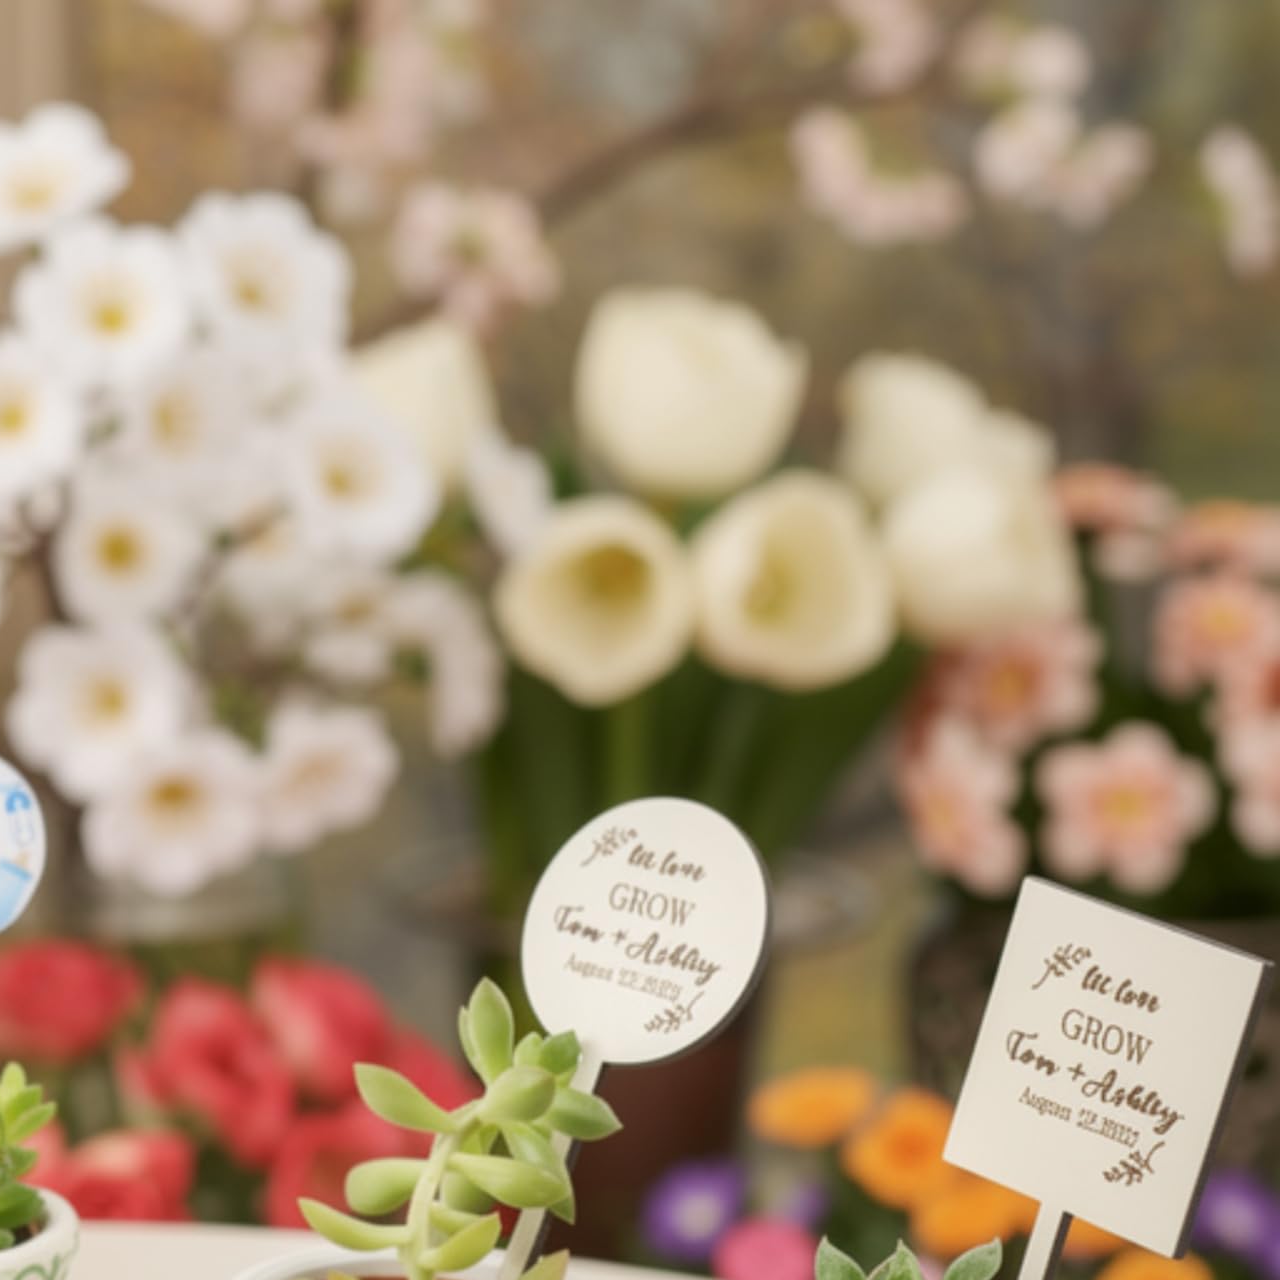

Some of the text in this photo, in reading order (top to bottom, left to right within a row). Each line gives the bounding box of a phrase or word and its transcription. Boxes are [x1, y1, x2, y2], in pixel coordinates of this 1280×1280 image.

[608, 883, 696, 927] GROW
[1061, 1008, 1154, 1065] GROW
[1005, 1029, 1061, 1077] Tom
[1081, 1069, 1185, 1135] Ashley
